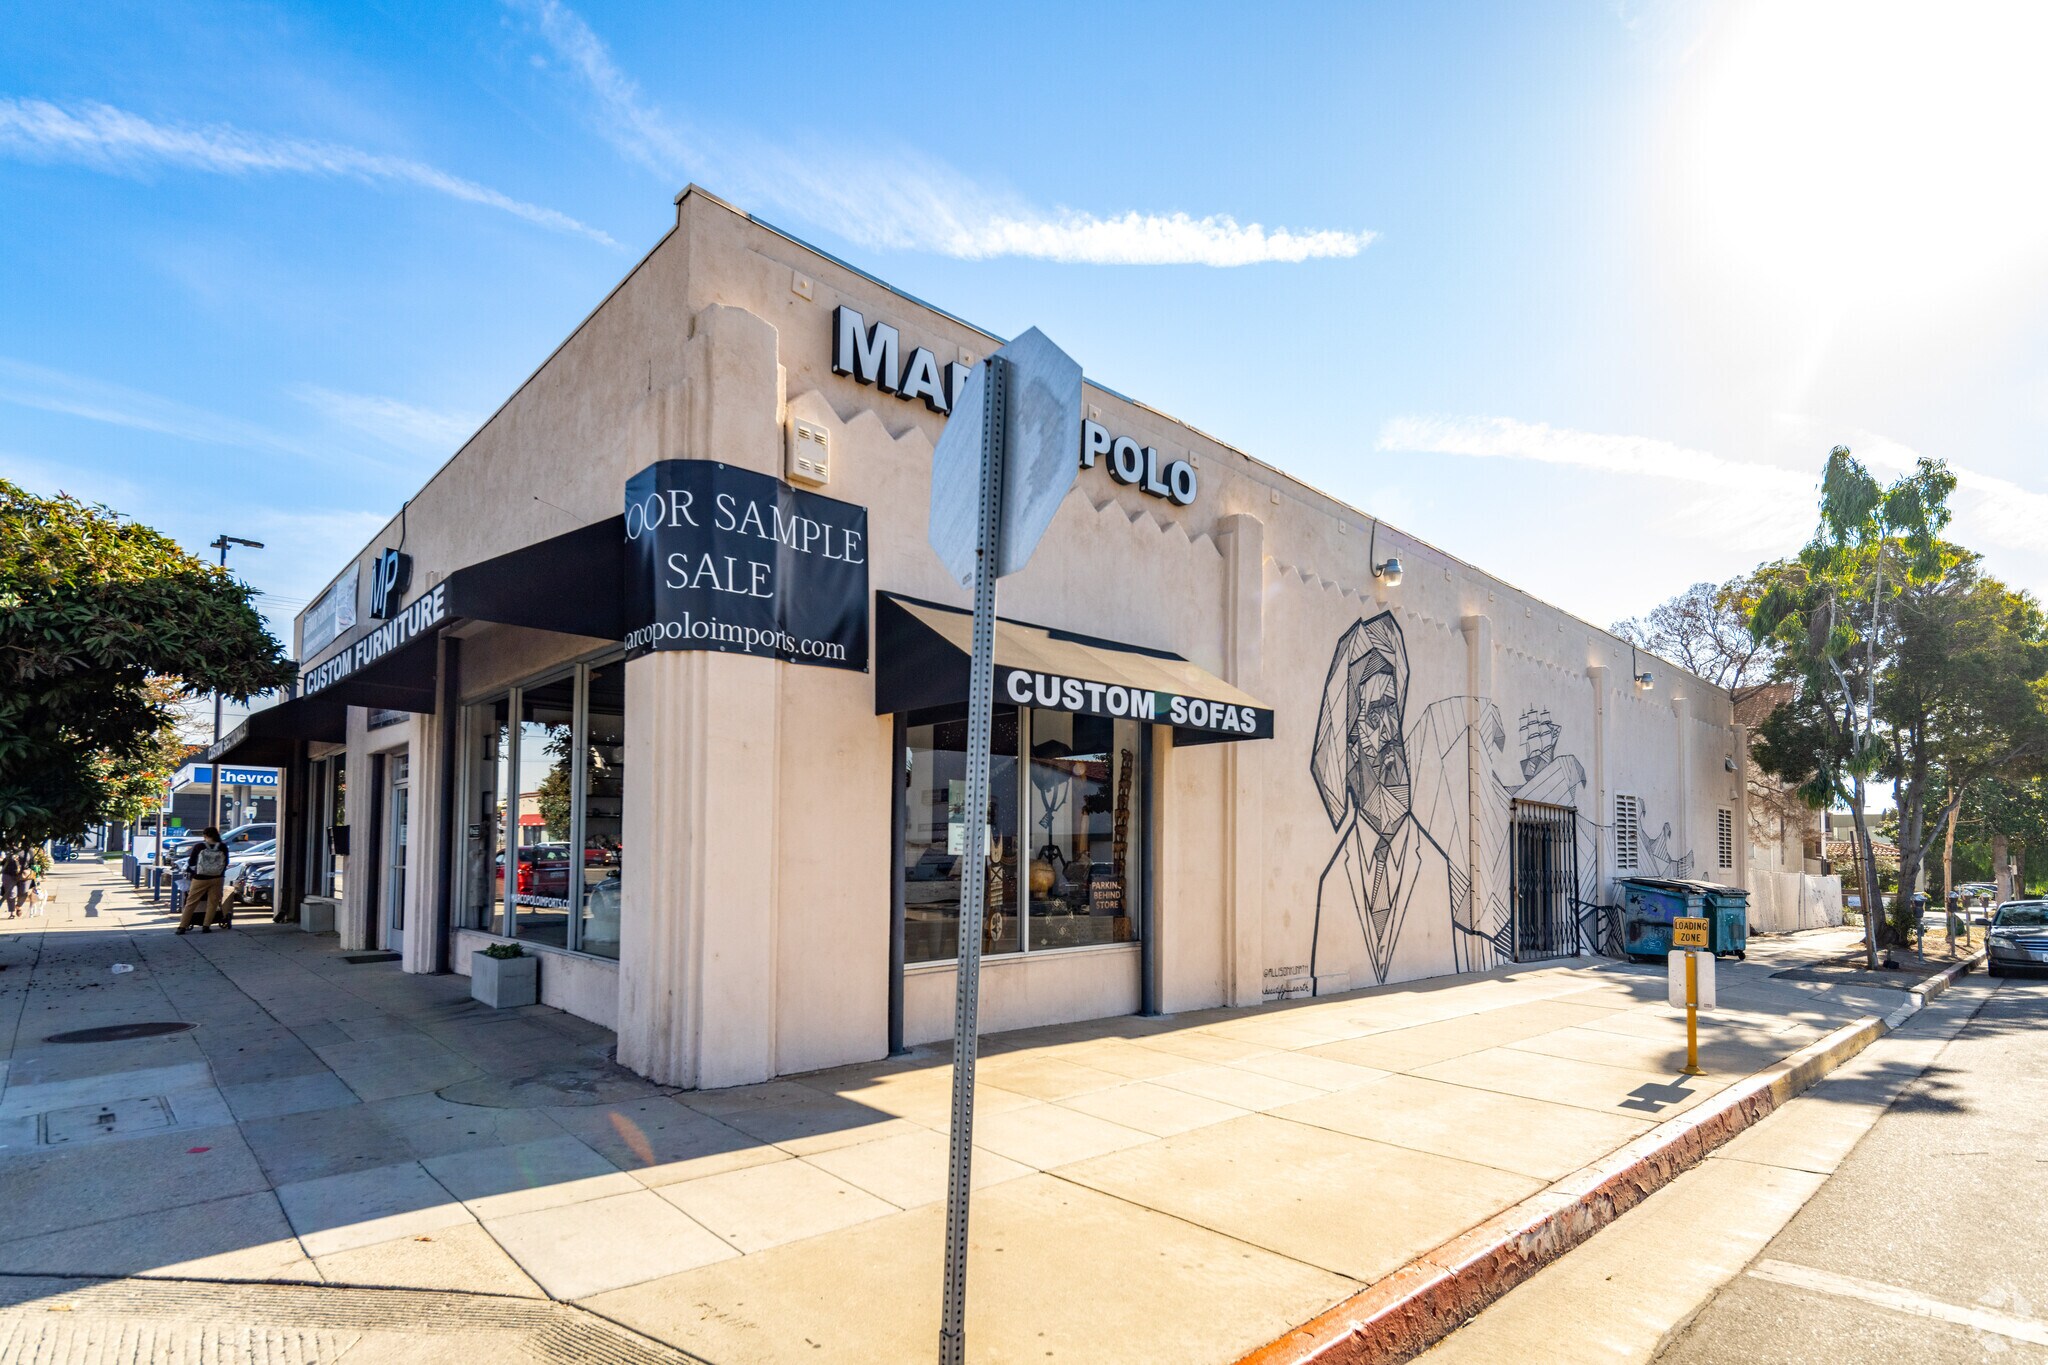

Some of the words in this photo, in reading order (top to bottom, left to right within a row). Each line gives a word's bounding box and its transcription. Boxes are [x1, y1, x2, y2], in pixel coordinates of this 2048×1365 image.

[1081, 418, 1198, 507] POLO
[624, 489, 699, 544] OOR
[715, 493, 865, 565] SAMPLE
[666, 553, 774, 598] SALE
[306, 652, 352, 696] CUSTOM
[355, 583, 446, 671] FURNITURE
[1007, 670, 1156, 720] CUSTOM
[1170, 695, 1257, 734] SOFAS
[1093, 891, 1121, 900] BEHIND
[1095, 901, 1119, 909] STORE
[1674, 921, 1708, 931] LOADING
[1680, 932, 1701, 942] ZONE
